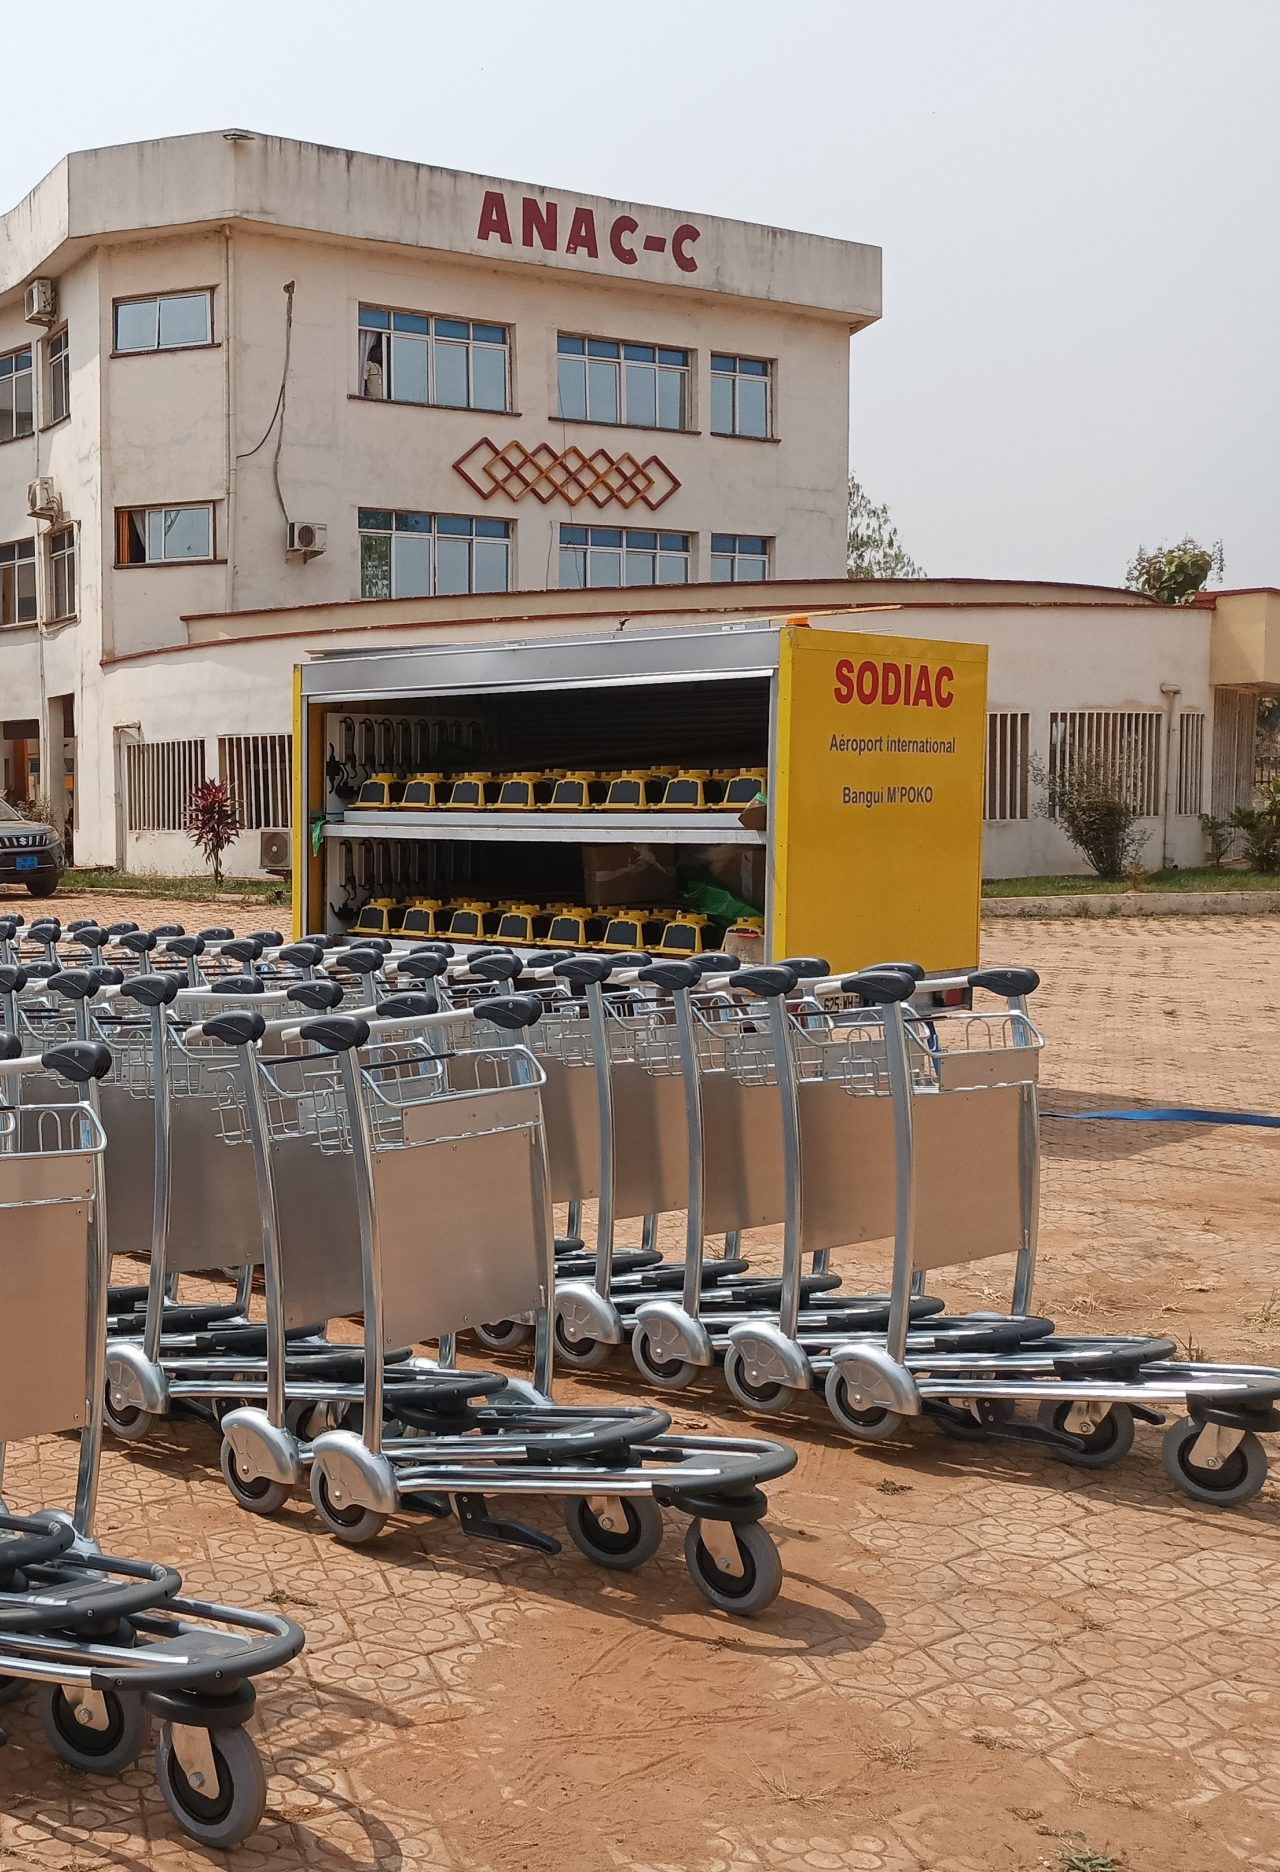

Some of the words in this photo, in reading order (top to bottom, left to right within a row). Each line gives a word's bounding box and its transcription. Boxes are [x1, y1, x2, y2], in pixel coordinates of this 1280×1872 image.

[477, 191, 701, 273] ANAC-C
[834, 659, 954, 708] SODIAC
[830, 734, 883, 755] Aéroport
[887, 736, 955, 753] international
[843, 787, 883, 808] Bangui
[886, 786, 933, 804] M'POKO
